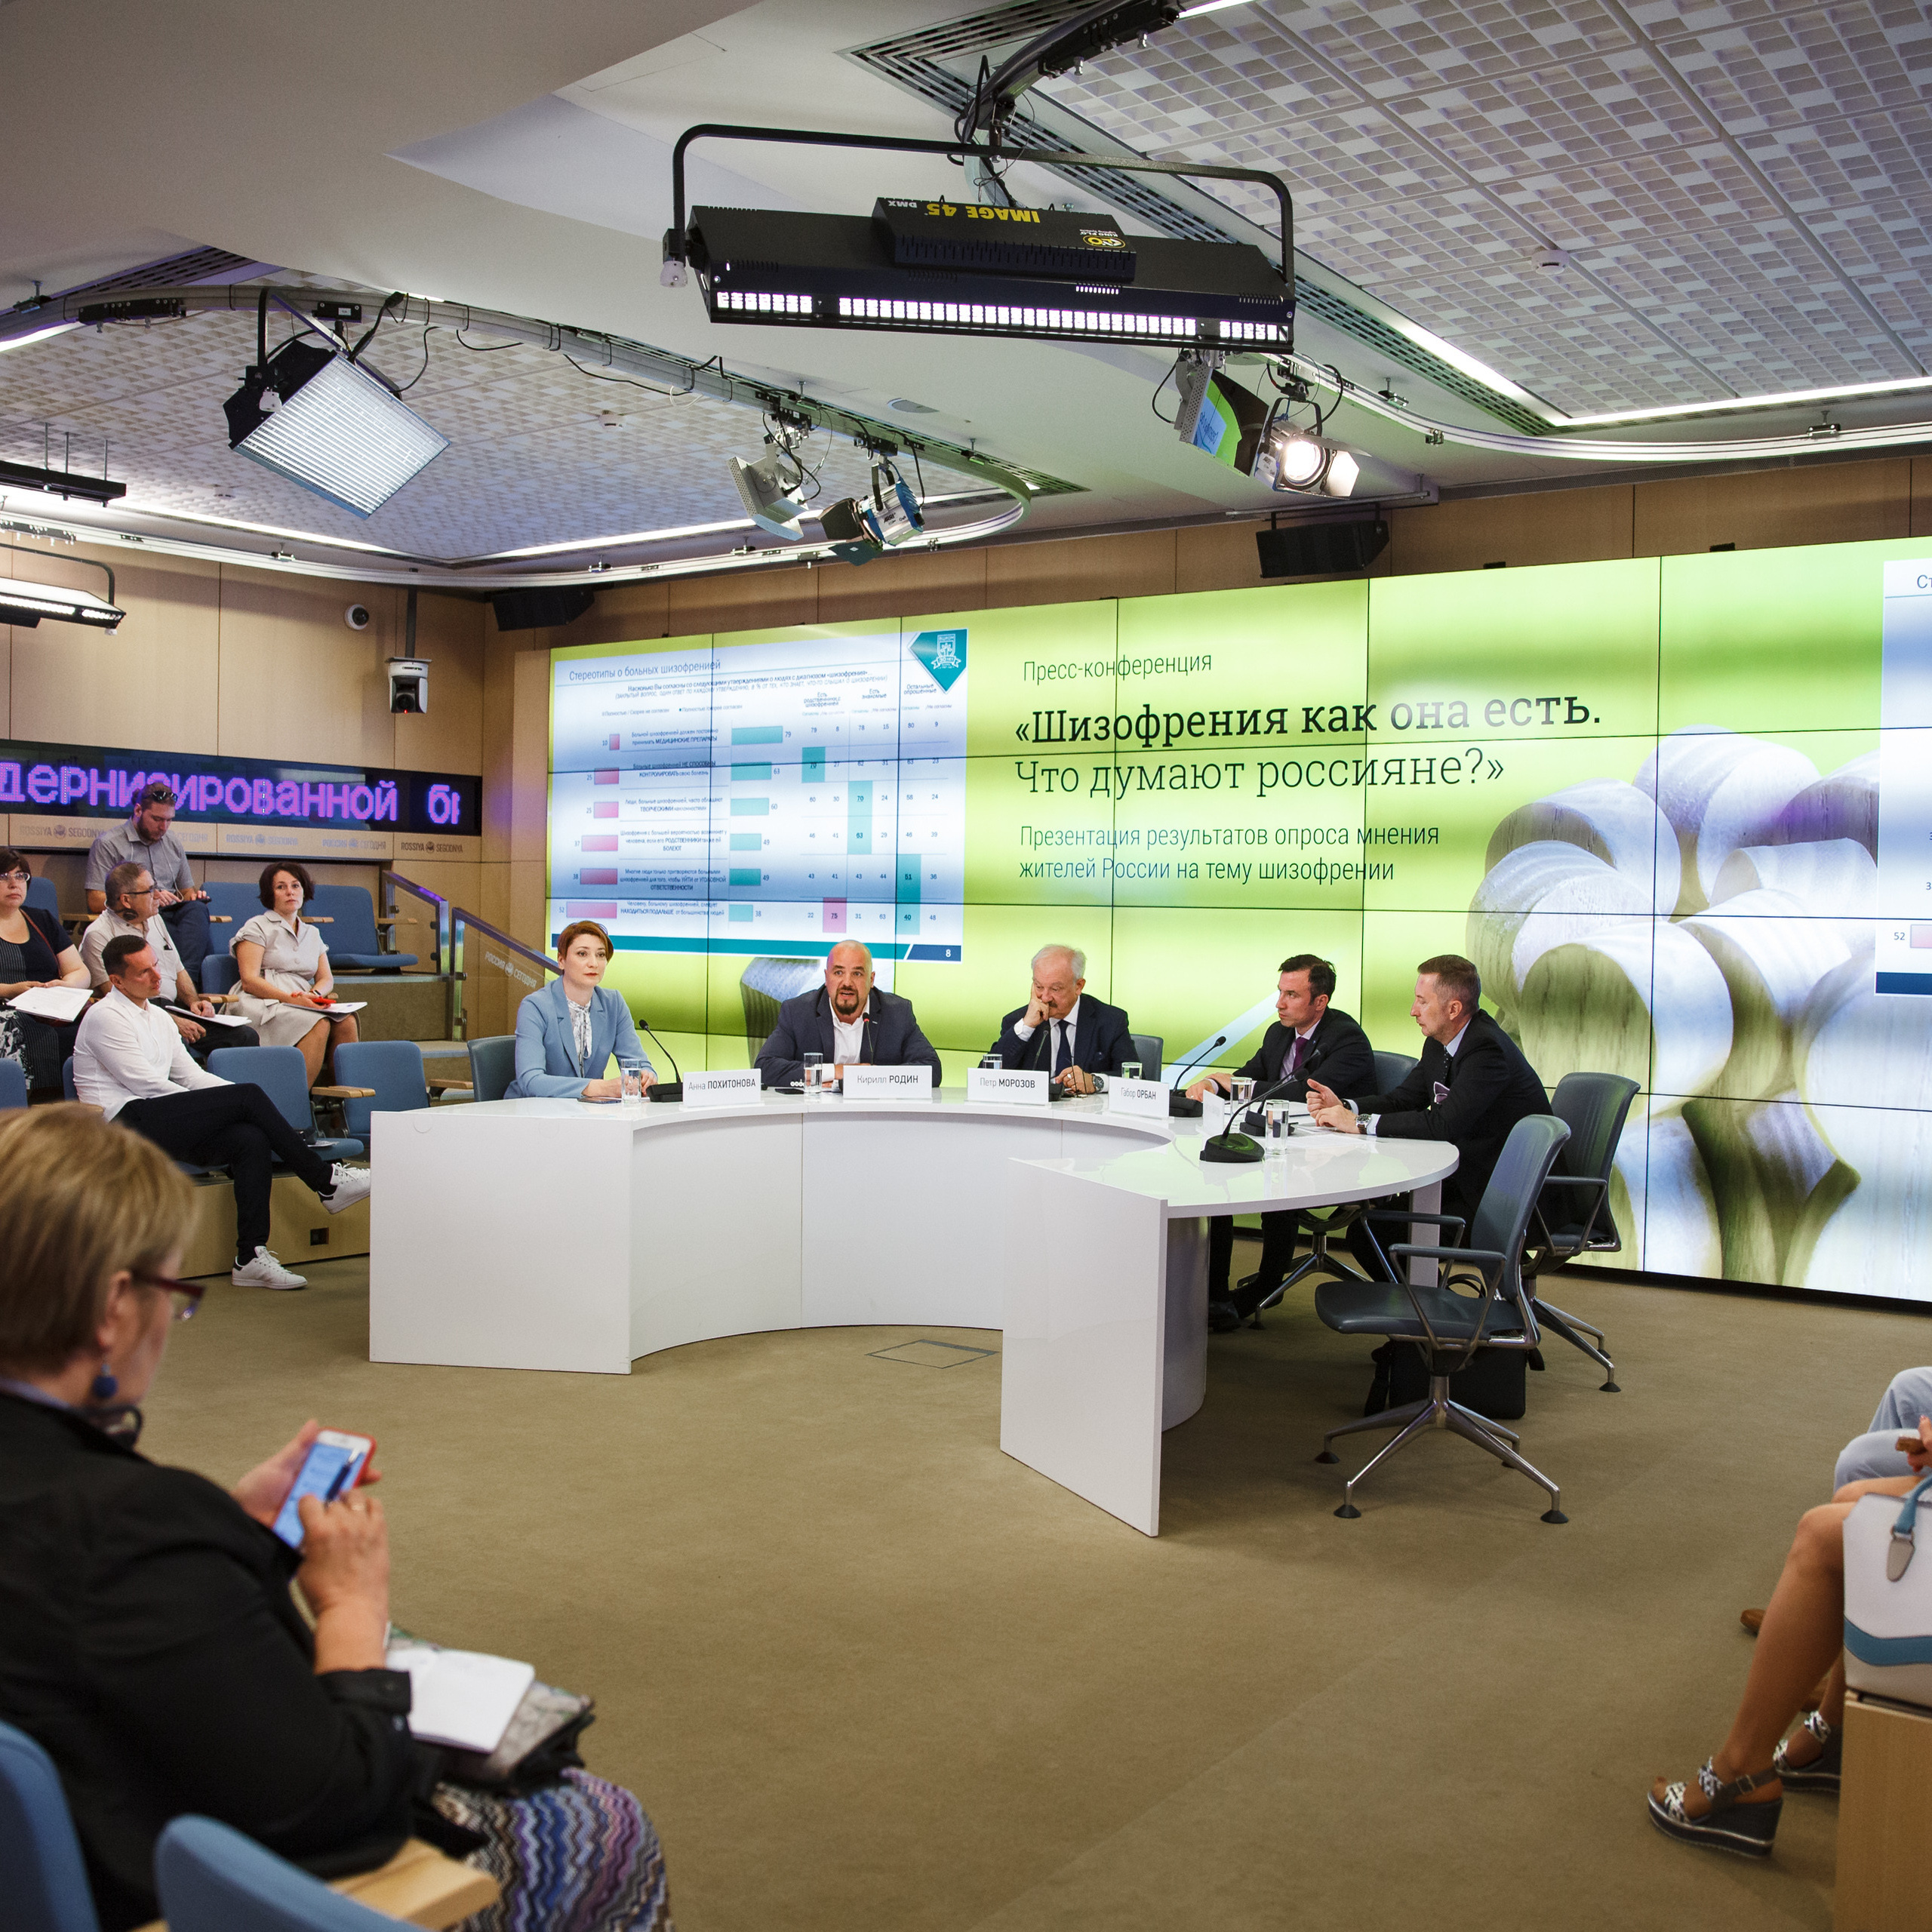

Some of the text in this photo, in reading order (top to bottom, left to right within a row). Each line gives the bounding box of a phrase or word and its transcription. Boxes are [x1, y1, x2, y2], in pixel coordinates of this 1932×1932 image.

[888, 200, 1041, 223] IMAGE 45 DMX
[569, 658, 721, 681] Стереотипы о больных шизофренией
[1023, 654, 1211, 685] Пресс-конференция
[1015, 695, 1600, 747] «Шизофрения как она есть.
[1015, 747, 1504, 800] Что думают россияне?»
[401, 841, 463, 853] ROSSIYA SEGODNYA
[1020, 826, 1439, 851] Презентация результатов опроса мнения
[1019, 857, 1394, 885] жителей России на тему шизофрении
[1894, 931, 1906, 941] 52
[945, 949, 951, 958] 8
[688, 1078, 757, 1091] Анна ПОХИТОНОВА
[857, 1074, 919, 1085] Кирилл РОДИН
[980, 1077, 1036, 1089] Петр МОРОЗОВ
[1121, 1087, 1157, 1100] Габор ОРБАН
